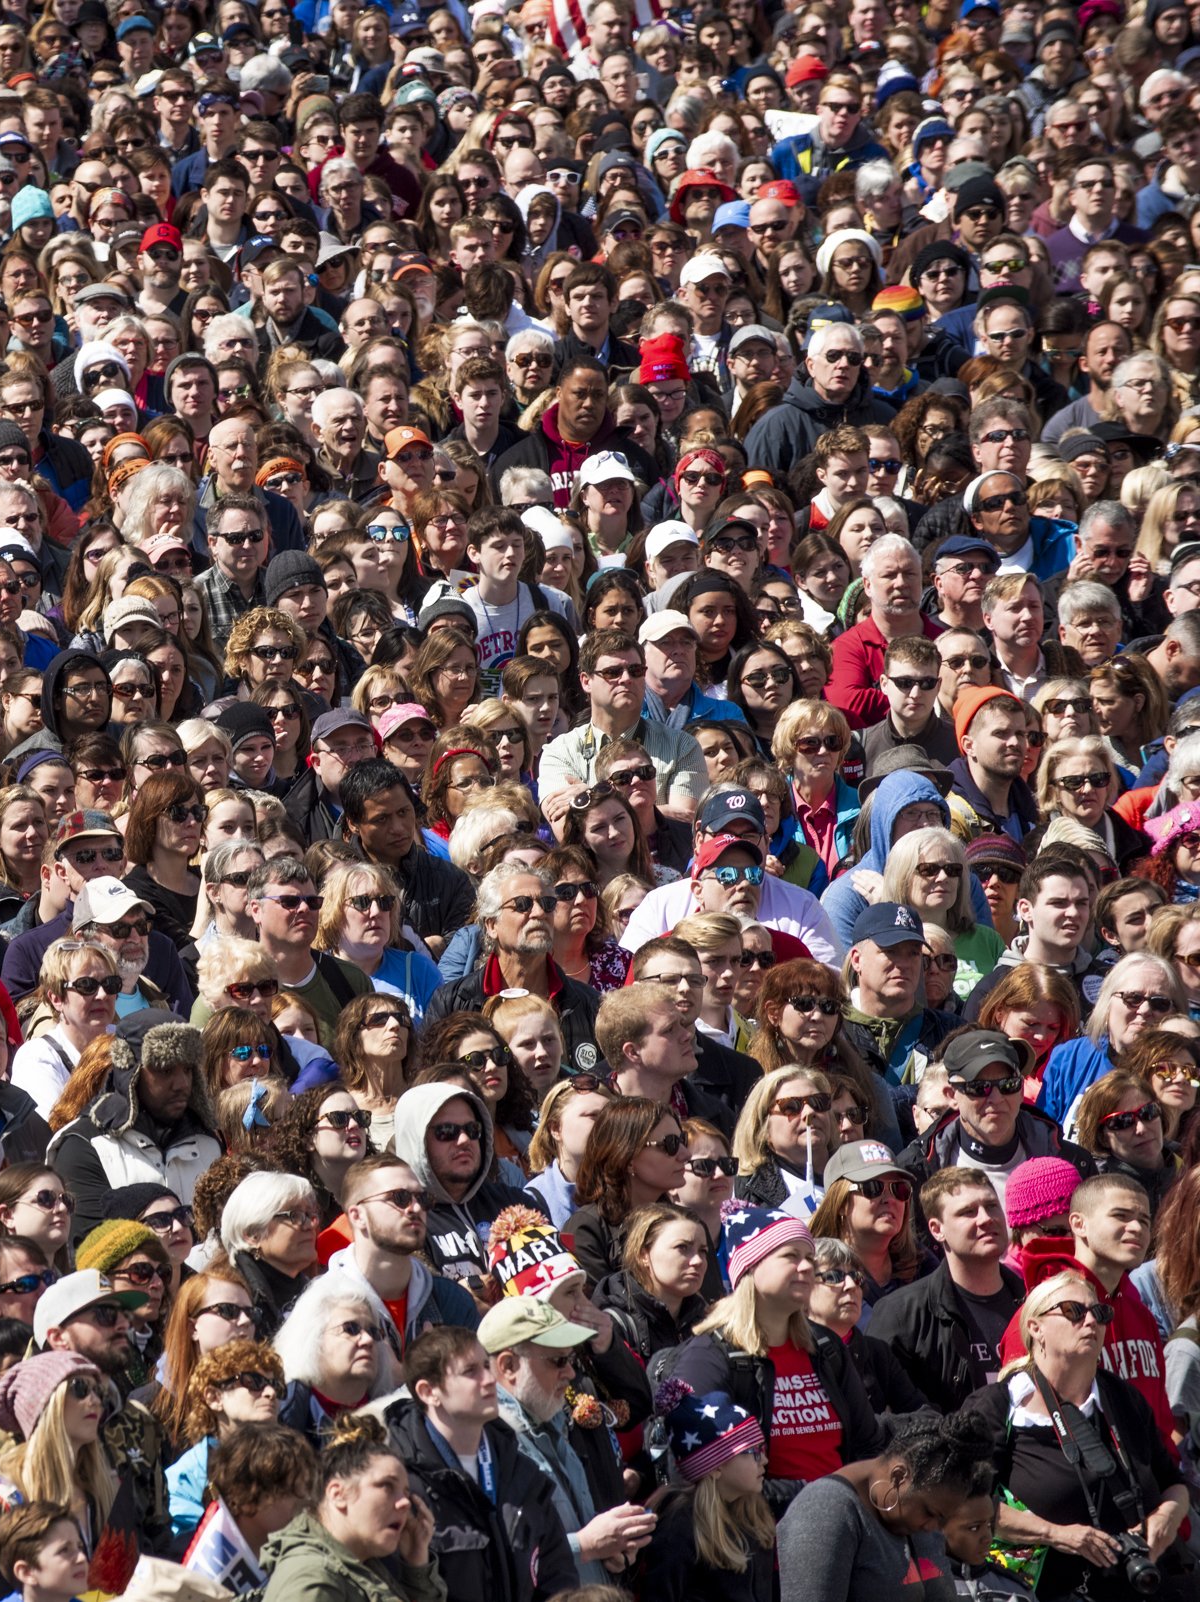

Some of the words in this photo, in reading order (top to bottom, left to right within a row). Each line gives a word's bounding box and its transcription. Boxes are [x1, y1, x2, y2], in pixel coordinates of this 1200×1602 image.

[726, 794, 746, 809] W
[774, 1374, 806, 1392] MS
[782, 1425, 796, 1436] GUN
[797, 1423, 815, 1434] SENSE
[824, 1420, 843, 1431] AMER
[1053, 1411, 1067, 1437] Canon
